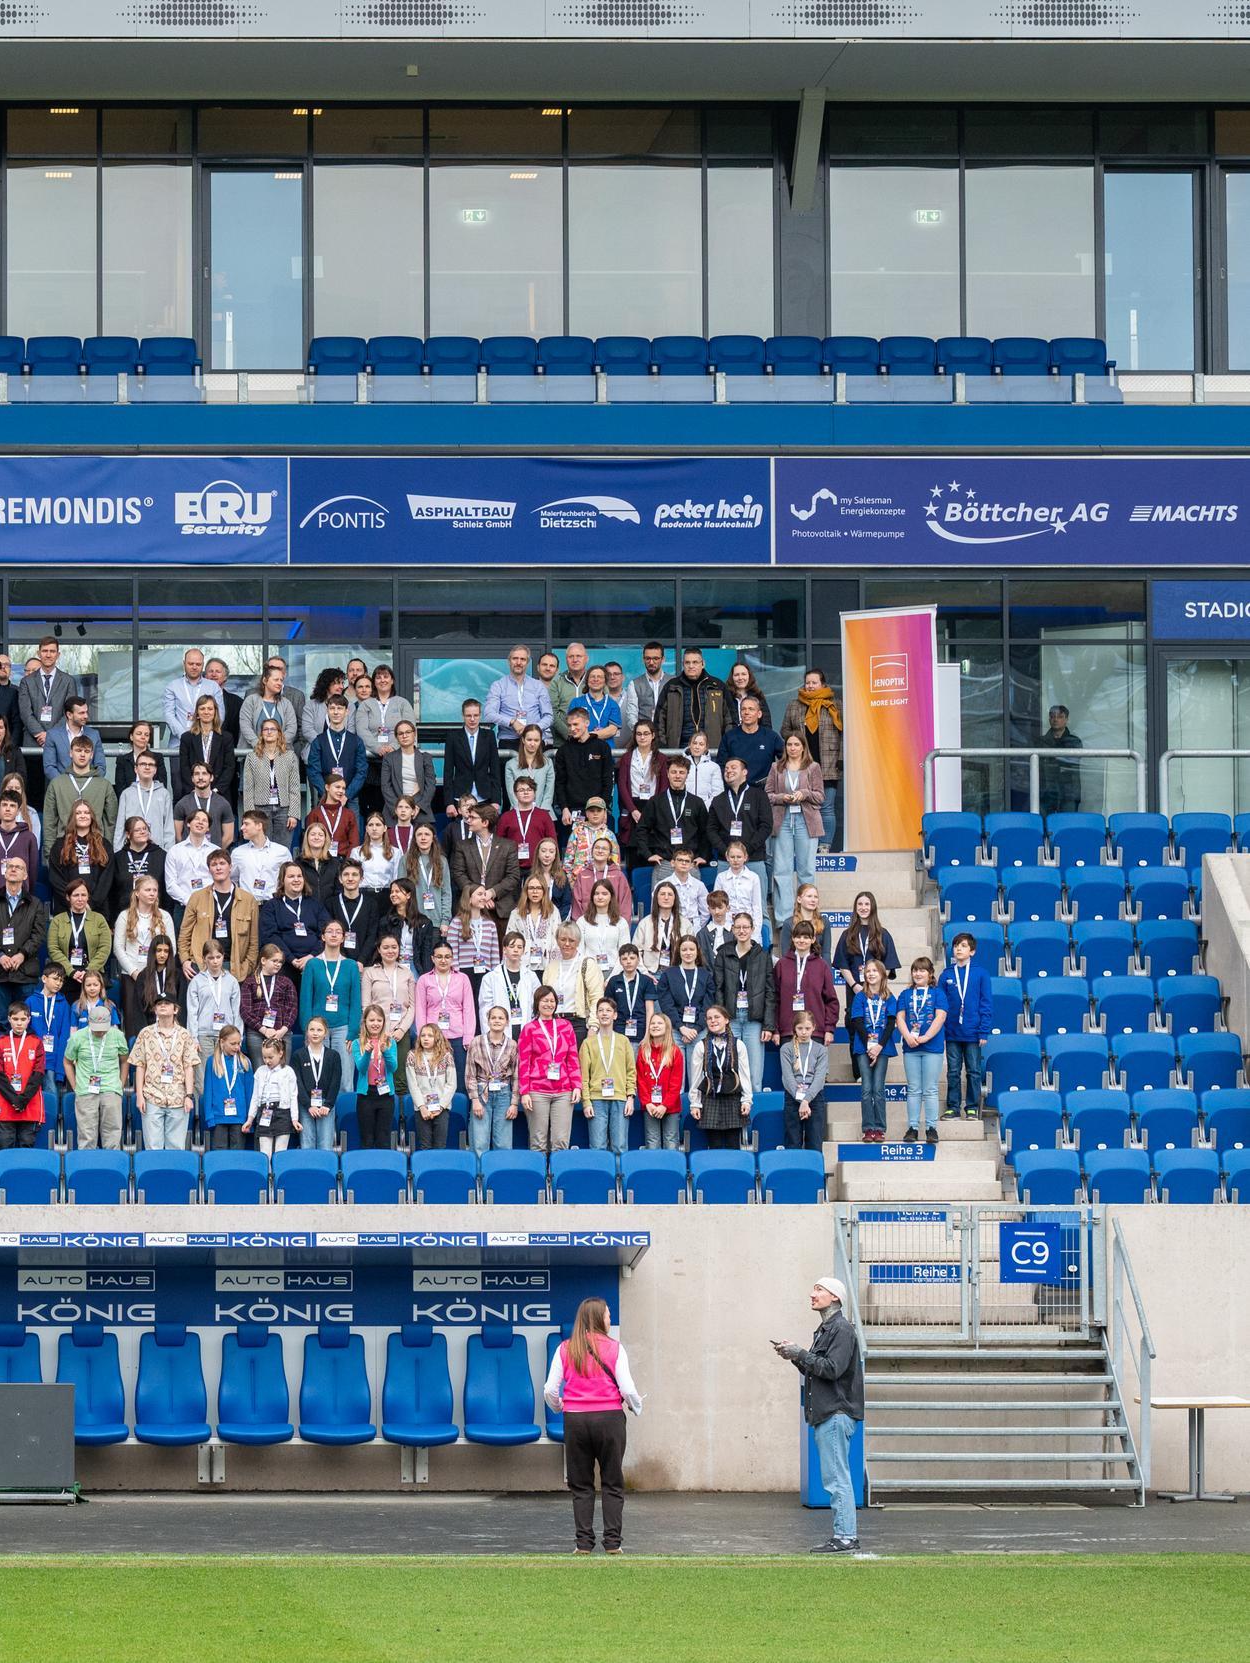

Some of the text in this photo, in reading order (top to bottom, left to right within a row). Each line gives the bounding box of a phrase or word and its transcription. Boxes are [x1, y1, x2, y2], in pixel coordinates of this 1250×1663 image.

[854, 496, 891, 504] Salesman
[415, 507, 510, 517] ASPHALTBAU
[654, 495, 764, 528] peter hein
[840, 507, 906, 517] Energiekonzepte
[945, 503, 1110, 522] Böttcher AG
[1151, 505, 1238, 522] MACHTS
[318, 512, 385, 528] PONTIS
[453, 520, 512, 528] Schleiz GmbH
[540, 517, 593, 528] Dietzsch
[661, 520, 753, 529] modernste Haustechnik
[181, 523, 267, 536] Security
[792, 530, 905, 539] Photovoltaik Wärmepumpe
[874, 677, 905, 687] JENOPTIK
[815, 858, 846, 867] eihe 8
[900, 1086, 907, 1096] 4
[882, 1145, 924, 1155] Reihe 3
[65, 1233, 139, 1246] KÖNIG
[232, 1233, 306, 1246] KÖNIG
[402, 1233, 477, 1246] KÖNIG
[574, 1233, 648, 1246] KÖNIG
[1011, 1242, 1049, 1265] C9
[914, 1267, 957, 1277] Reihe 1
[24, 1276, 151, 1285] AUTO HAUS
[222, 1276, 349, 1285] AUTO HAUS
[420, 1276, 547, 1285] AUTO HAUS
[17, 1297, 155, 1321] KÖNIG
[215, 1297, 353, 1321] KÖNIG
[413, 1297, 551, 1321] KÖNIG
